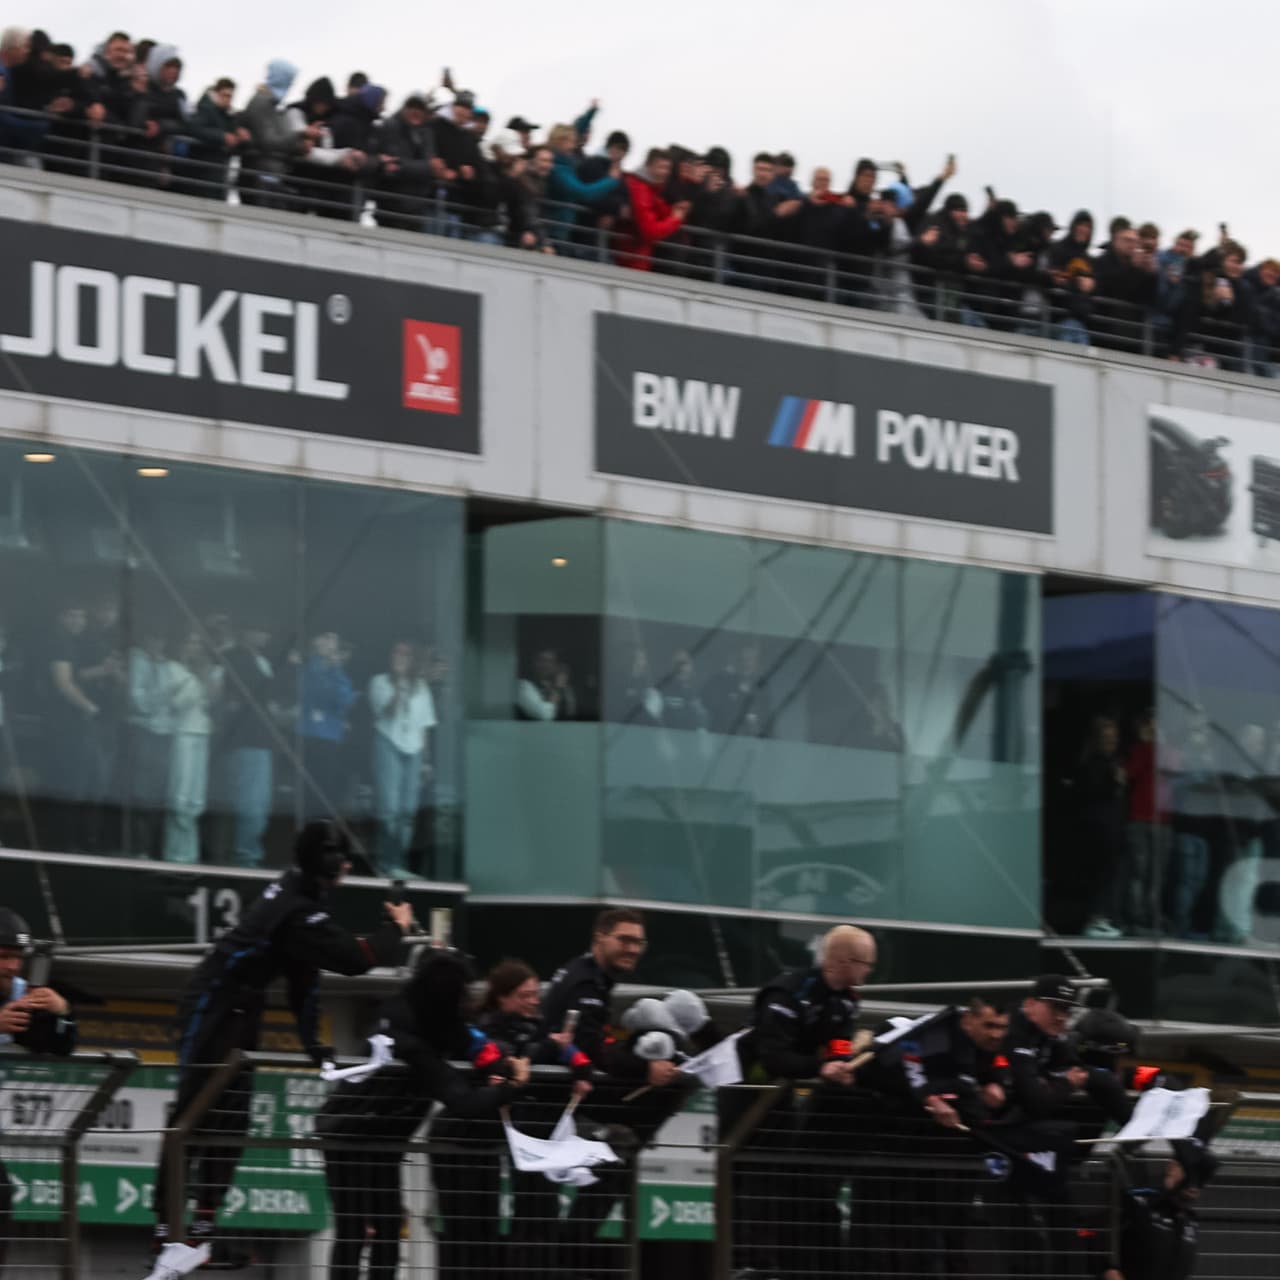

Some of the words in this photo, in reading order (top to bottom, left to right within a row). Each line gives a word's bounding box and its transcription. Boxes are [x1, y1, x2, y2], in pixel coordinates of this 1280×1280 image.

[1, 261, 349, 399] JOCKEL
[633, 372, 741, 440] BMW
[877, 409, 1021, 482] POWER
